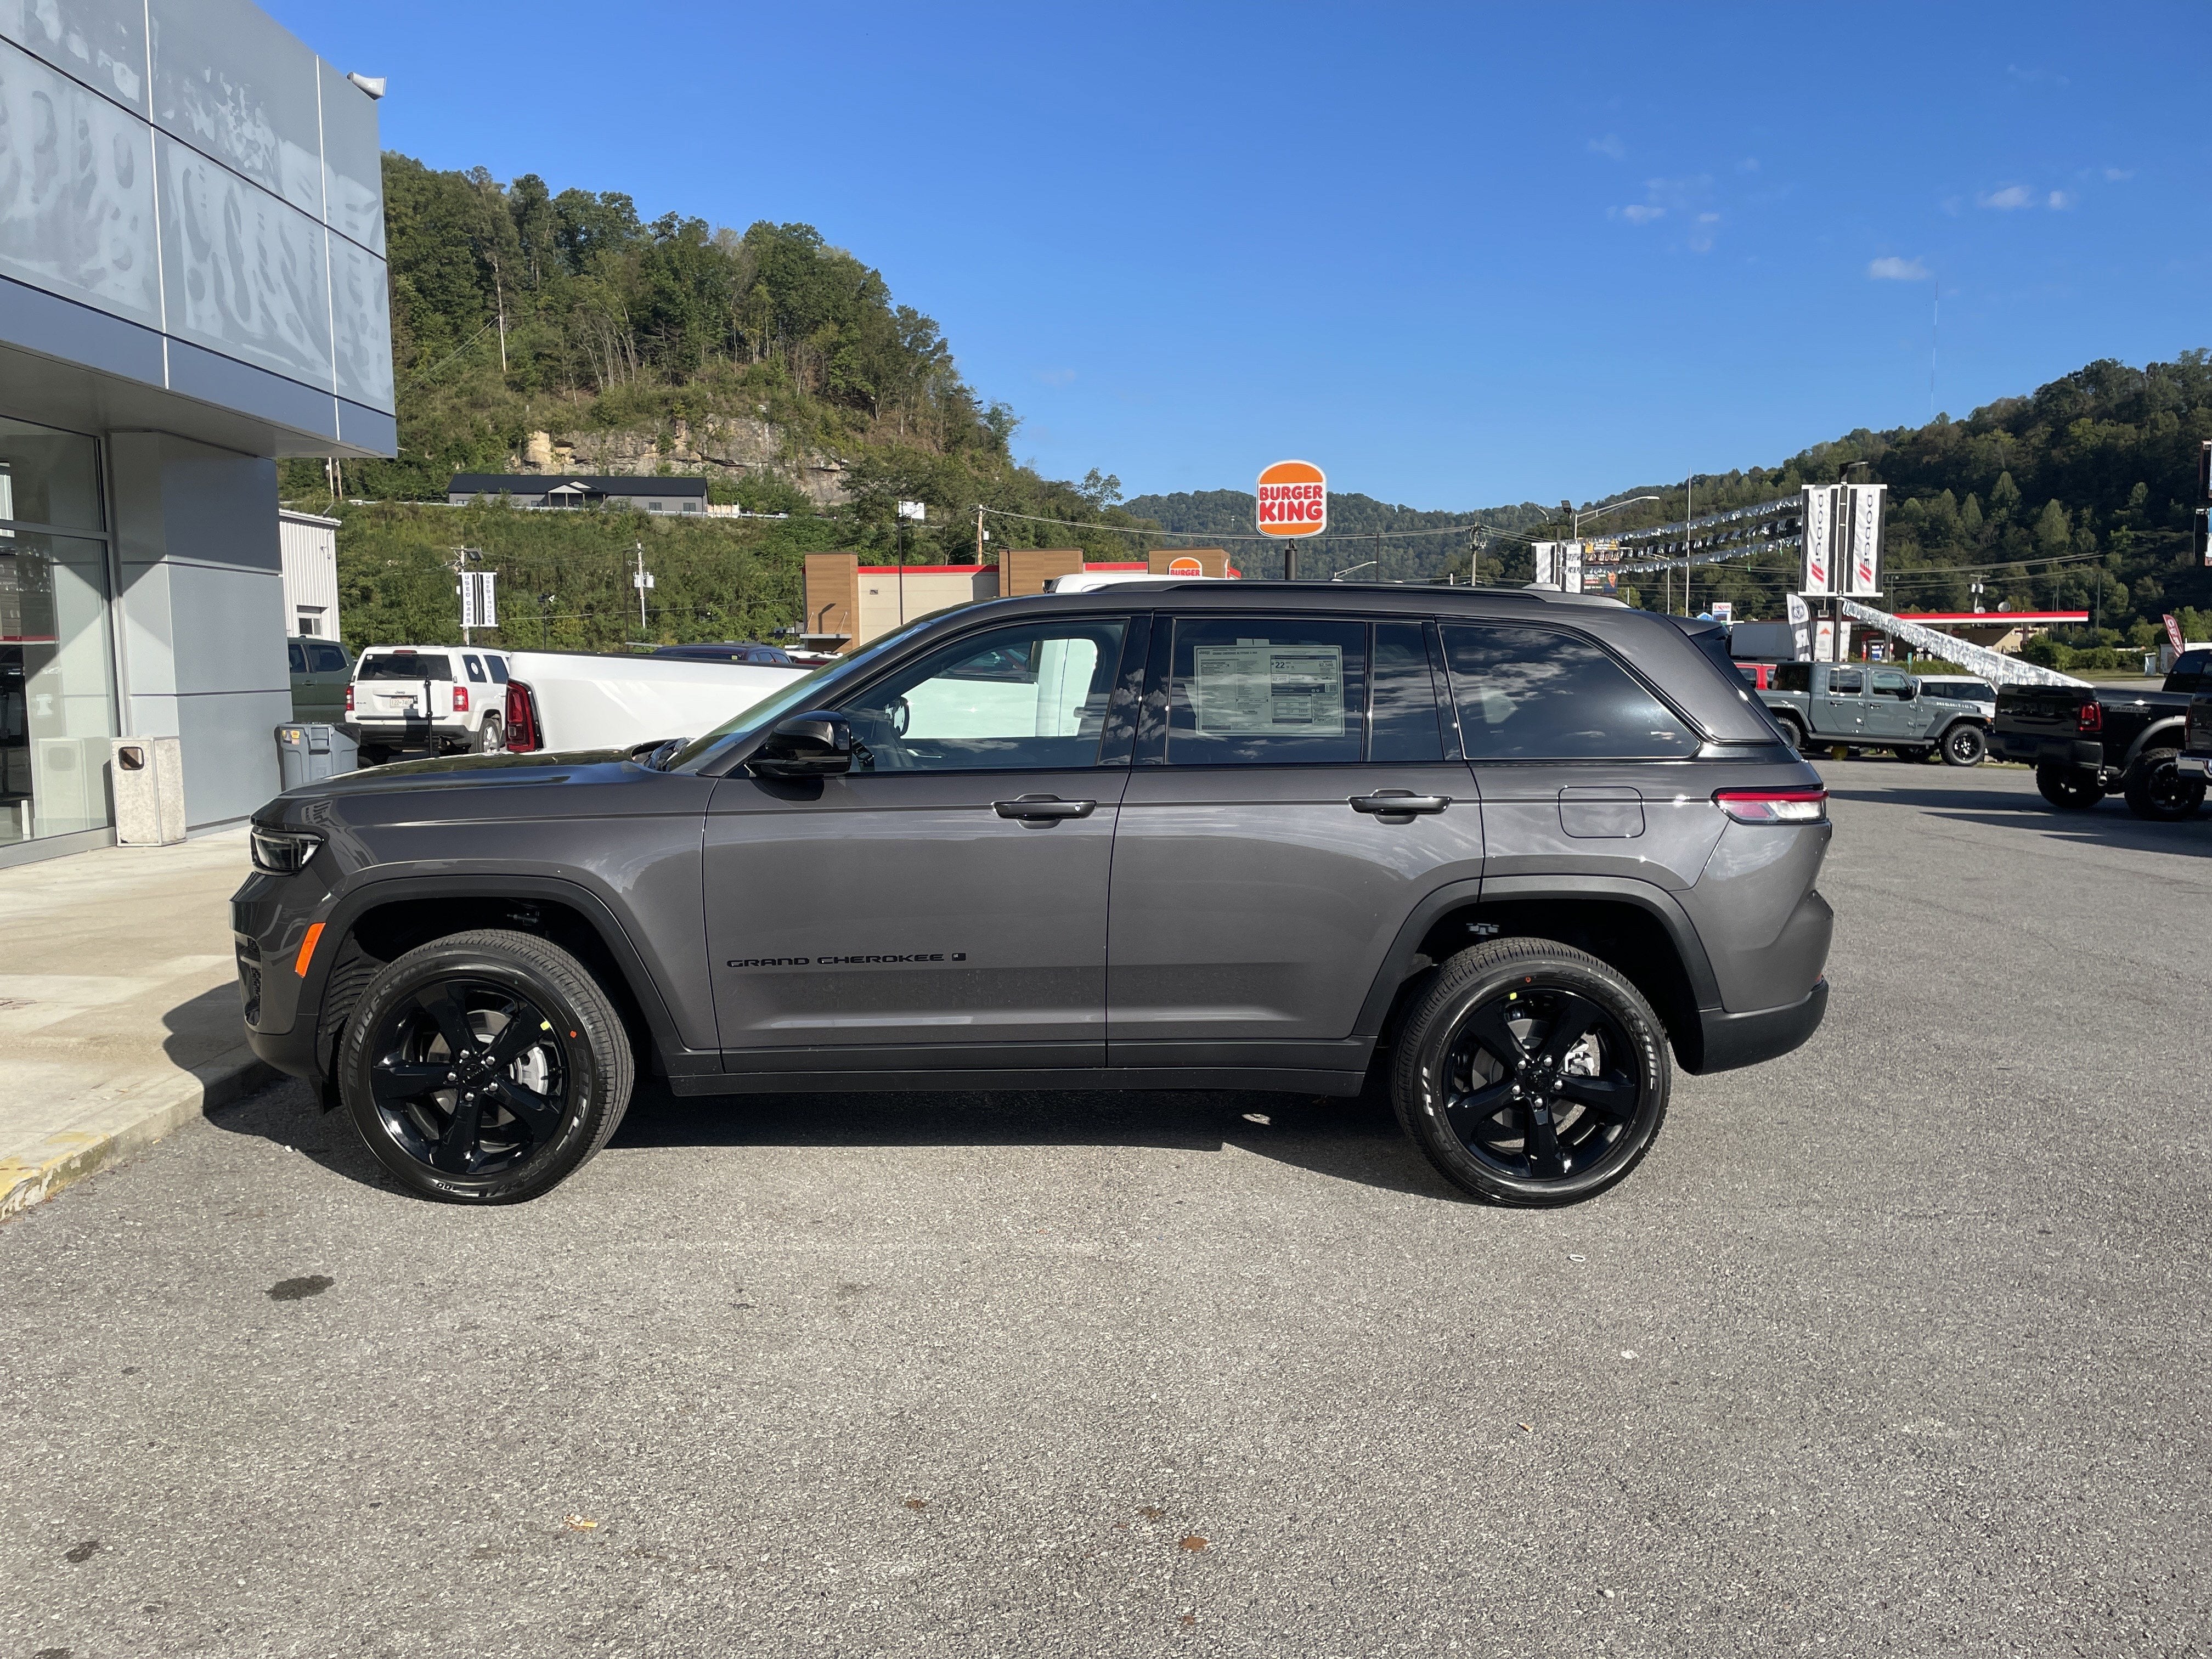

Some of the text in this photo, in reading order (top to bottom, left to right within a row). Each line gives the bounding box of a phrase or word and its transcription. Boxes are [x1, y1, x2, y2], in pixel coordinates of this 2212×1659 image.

[1260, 485, 1323, 501] BURGER
[1260, 500, 1323, 522] KING
[1815, 494, 1824, 570] DODGE
[1864, 494, 1872, 570] DODGE
[726, 953, 945, 968] GRAND CHEROKEE
